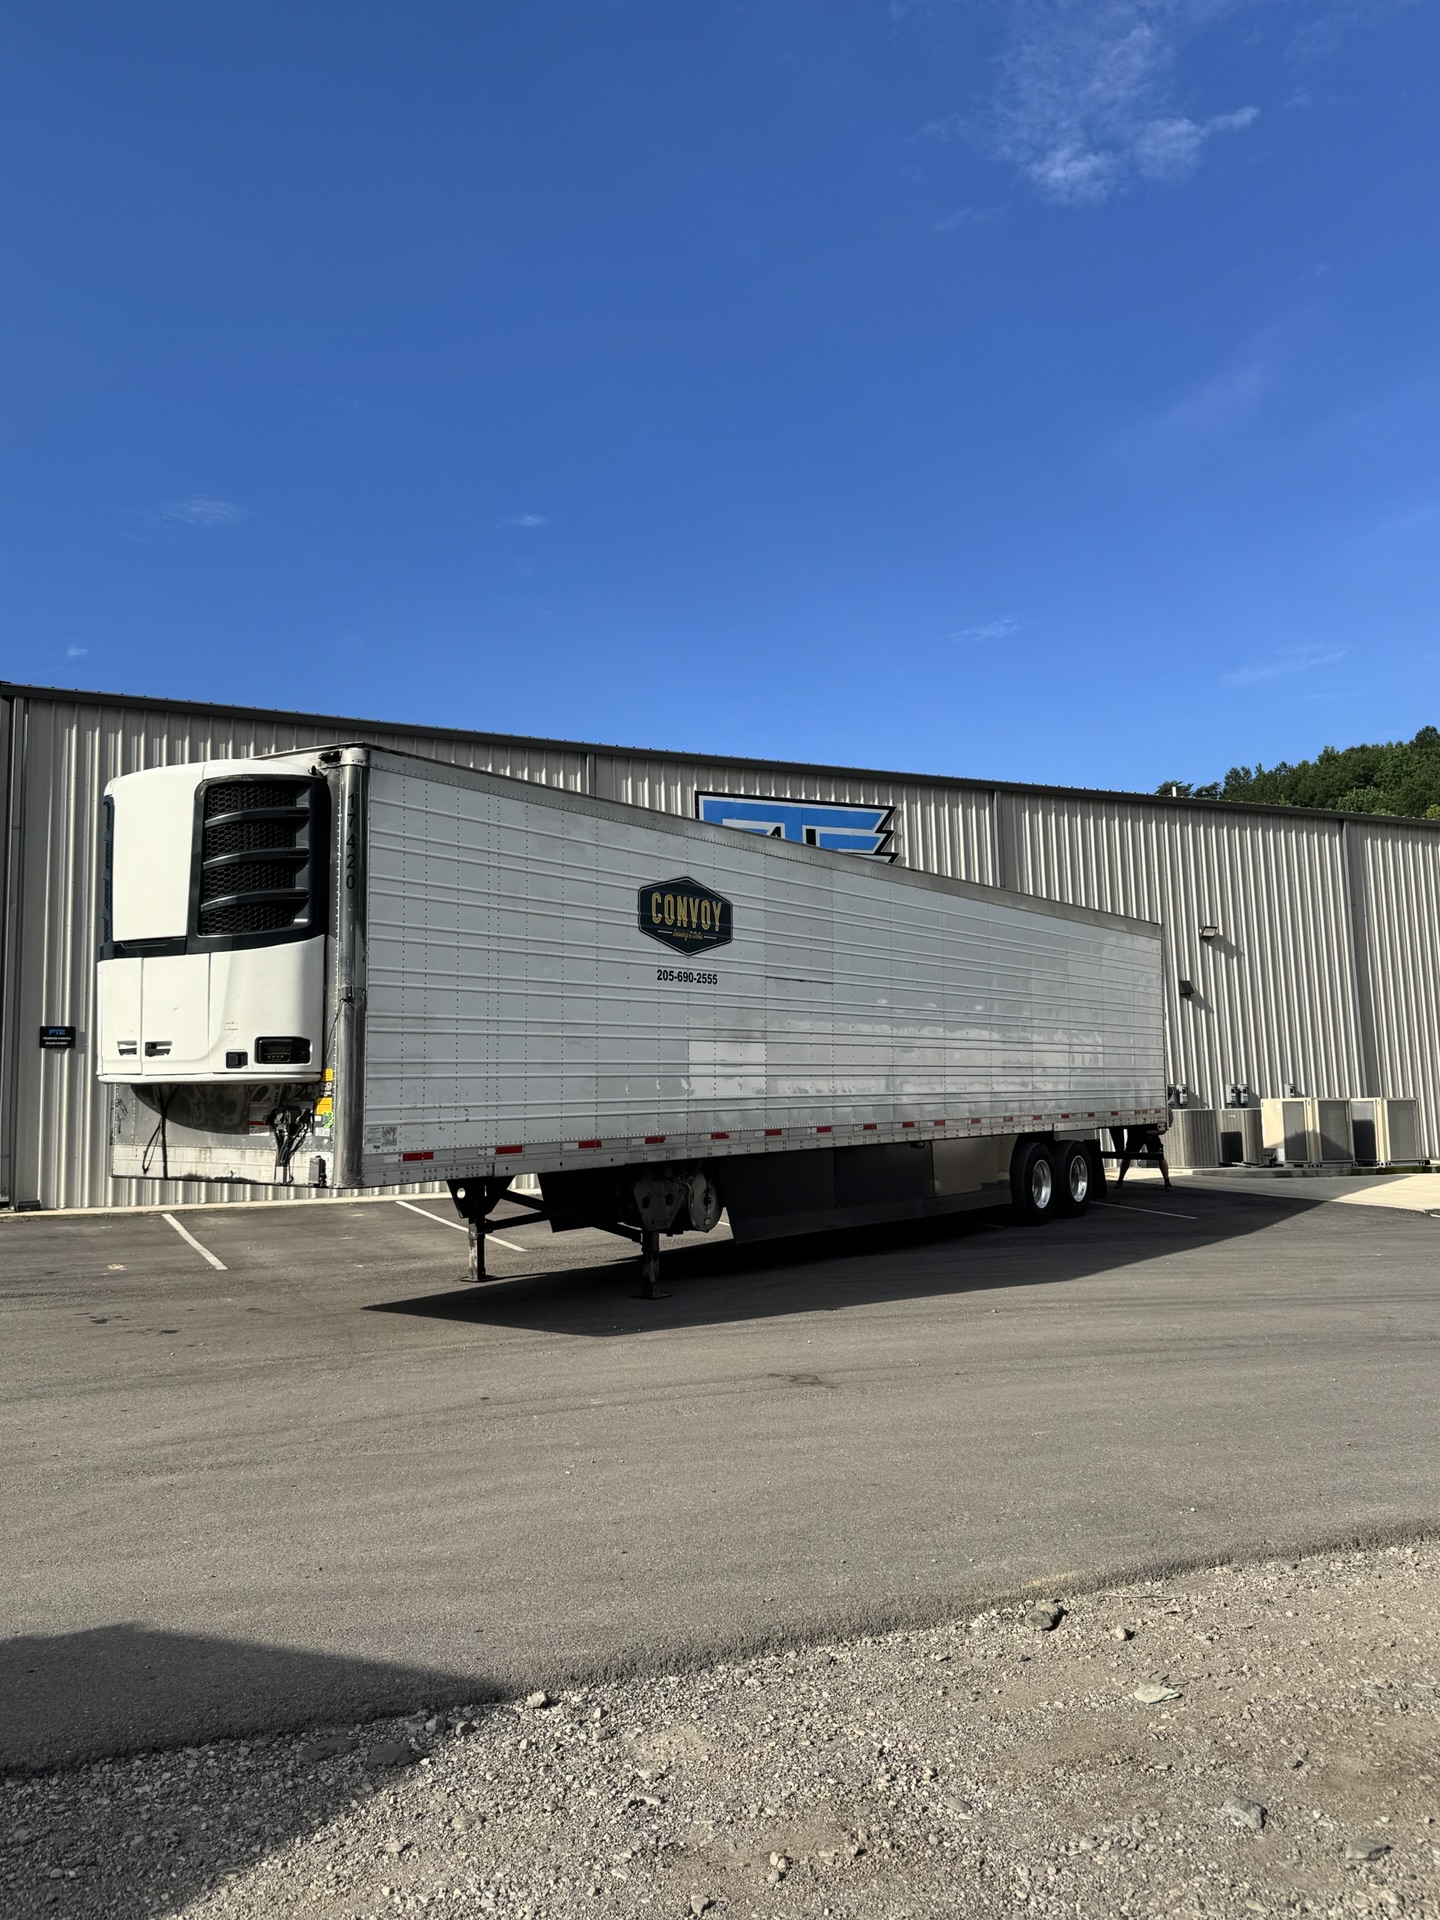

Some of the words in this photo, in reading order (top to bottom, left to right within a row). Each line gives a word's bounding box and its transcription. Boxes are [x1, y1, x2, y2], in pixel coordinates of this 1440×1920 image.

[346, 792, 357, 890] 17420
[651, 891, 723, 932] CONVOY
[656, 969, 718, 985] 205-690-2555
